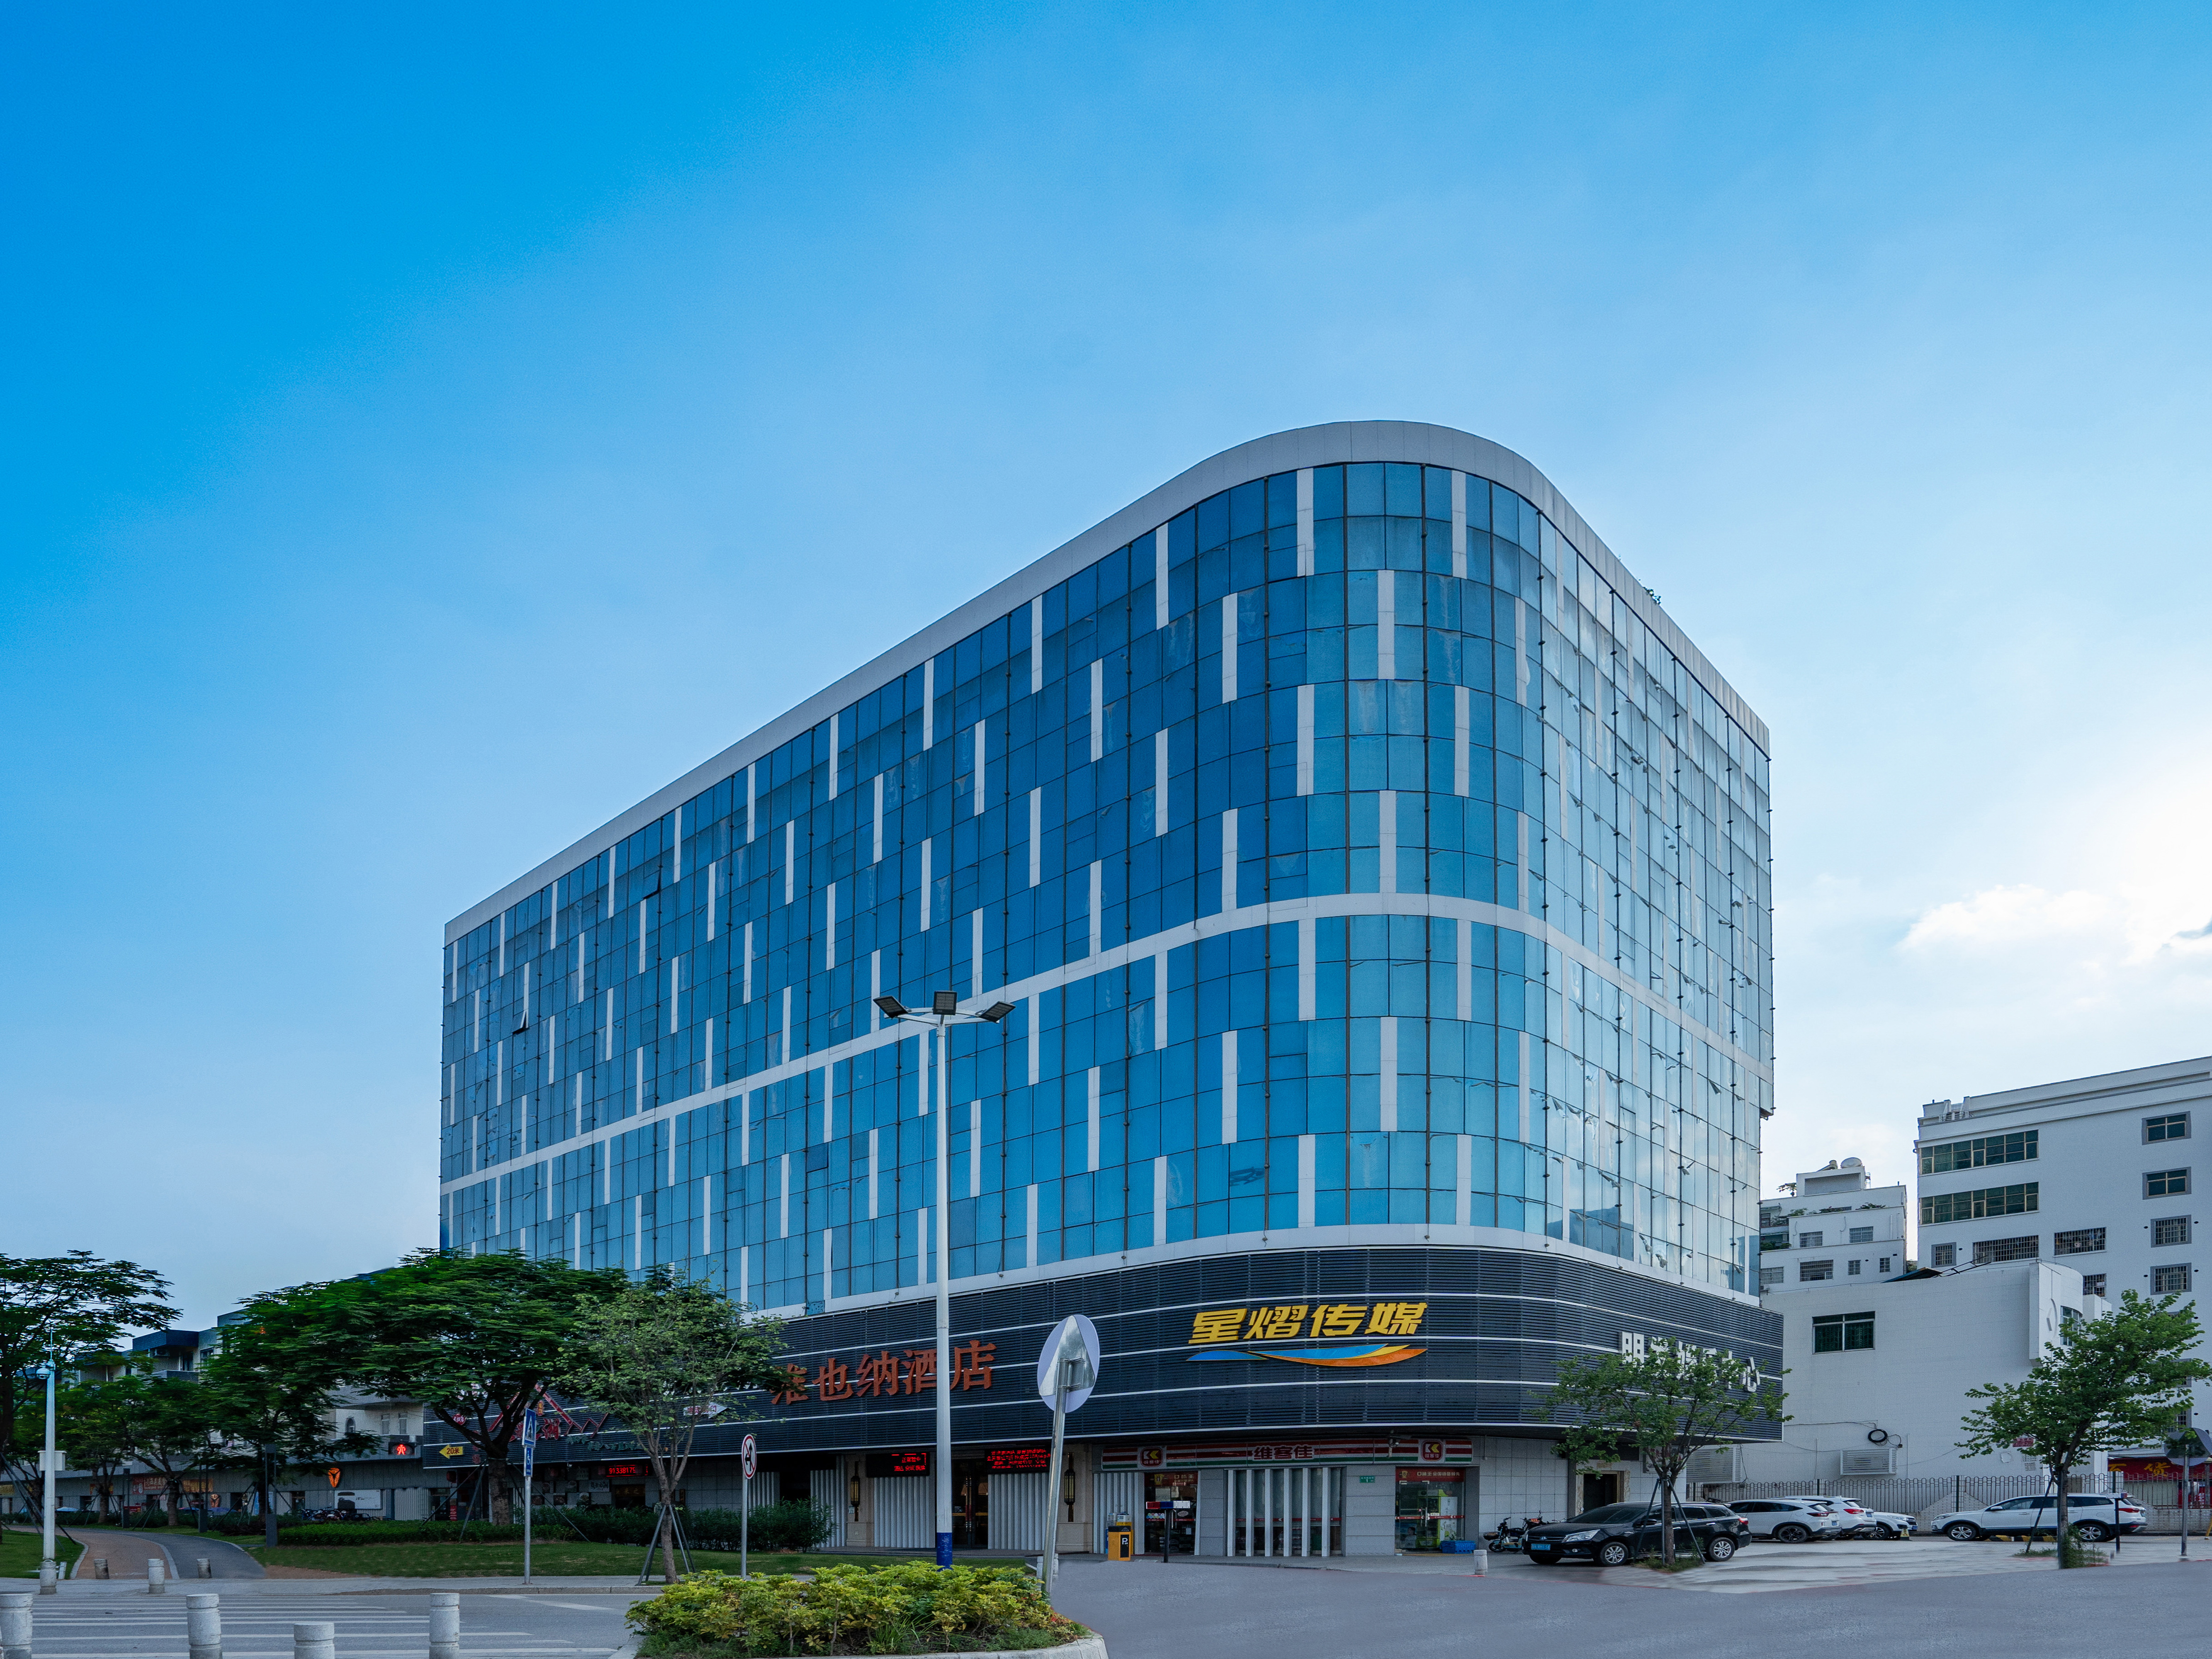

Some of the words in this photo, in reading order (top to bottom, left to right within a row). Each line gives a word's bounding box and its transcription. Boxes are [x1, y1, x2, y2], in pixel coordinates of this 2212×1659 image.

[1189, 1302, 1428, 1344] 星熠传媒
[1254, 1446, 1313, 1460] 维客佳
